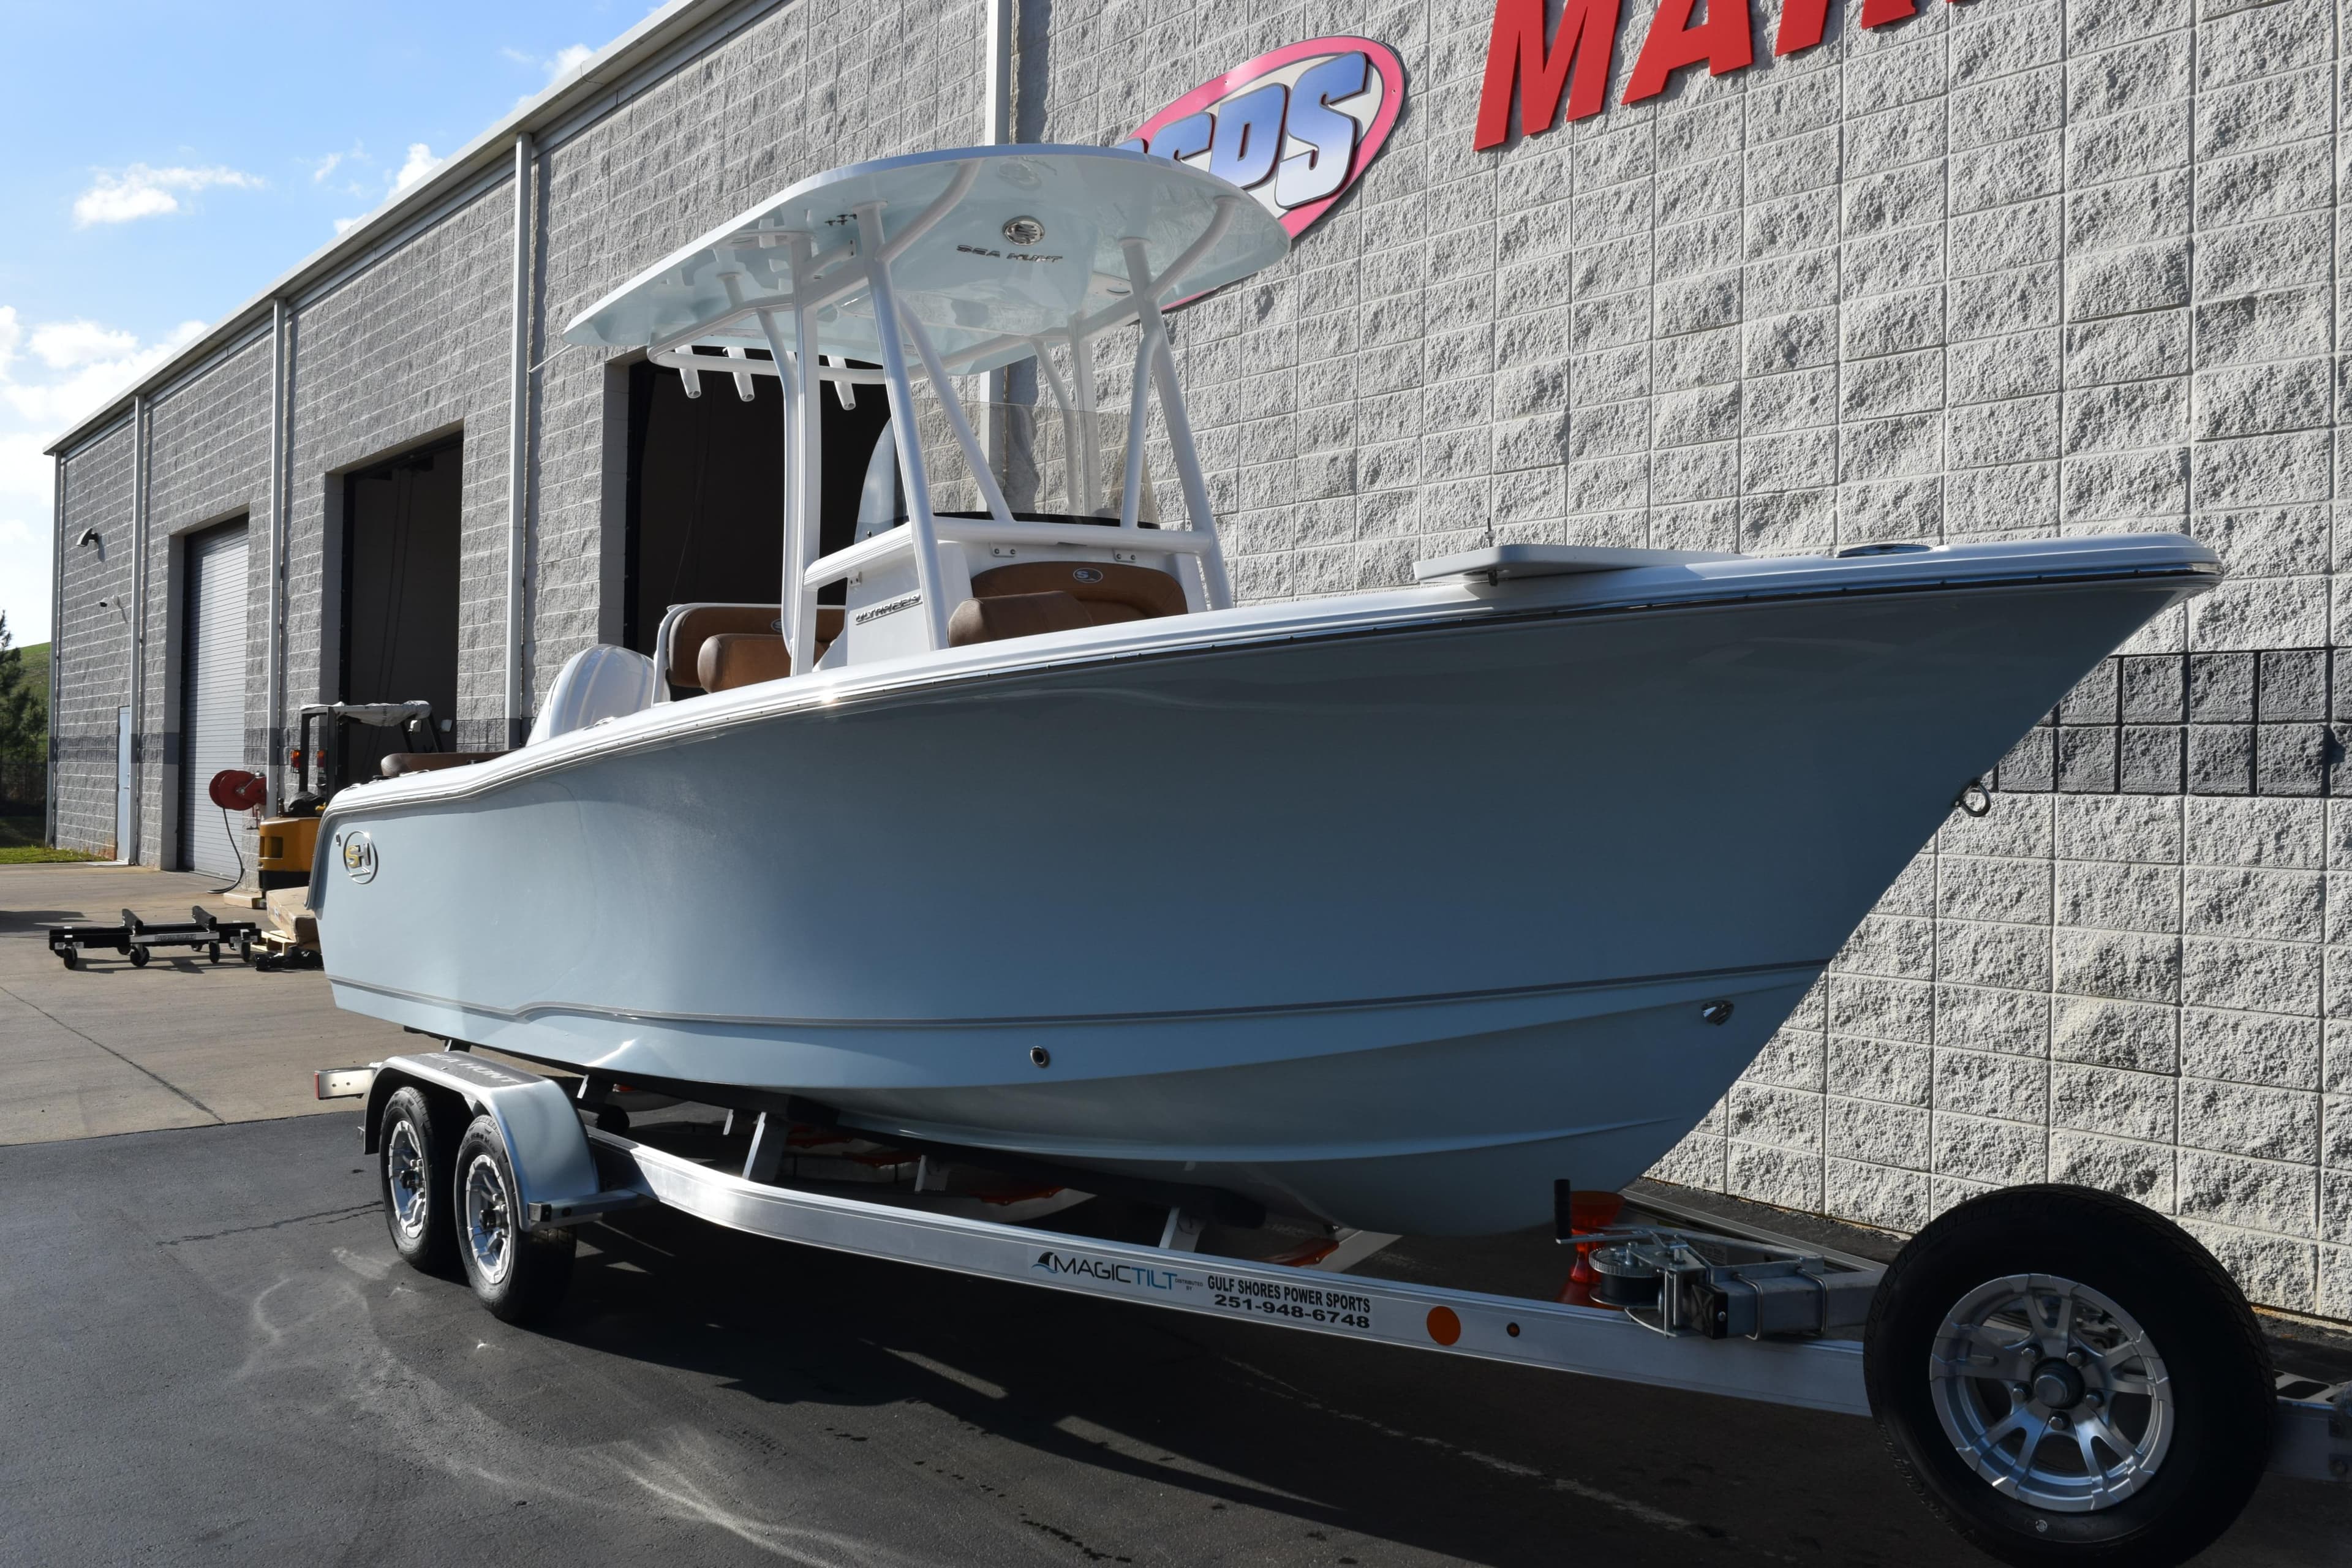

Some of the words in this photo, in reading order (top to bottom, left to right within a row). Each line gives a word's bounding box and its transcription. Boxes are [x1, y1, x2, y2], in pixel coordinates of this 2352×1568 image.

[1473, 0, 1916, 151] MA
[1115, 50, 1372, 210] PS
[956, 244, 1000, 258] SEA
[421, 1052, 461, 1063] SEA
[458, 1063, 522, 1084] HUNT
[1054, 1254, 1177, 1290] MAGICTILT
[1175, 1278, 1204, 1287] DISTRIBUTED
[1207, 1275, 1235, 1293] GULF
[1238, 1279, 1281, 1300] SHORES
[1284, 1286, 1323, 1306] POWER
[1326, 1292, 1371, 1313] SPORTS
[1214, 1294, 1370, 1329] 251-948-6748
